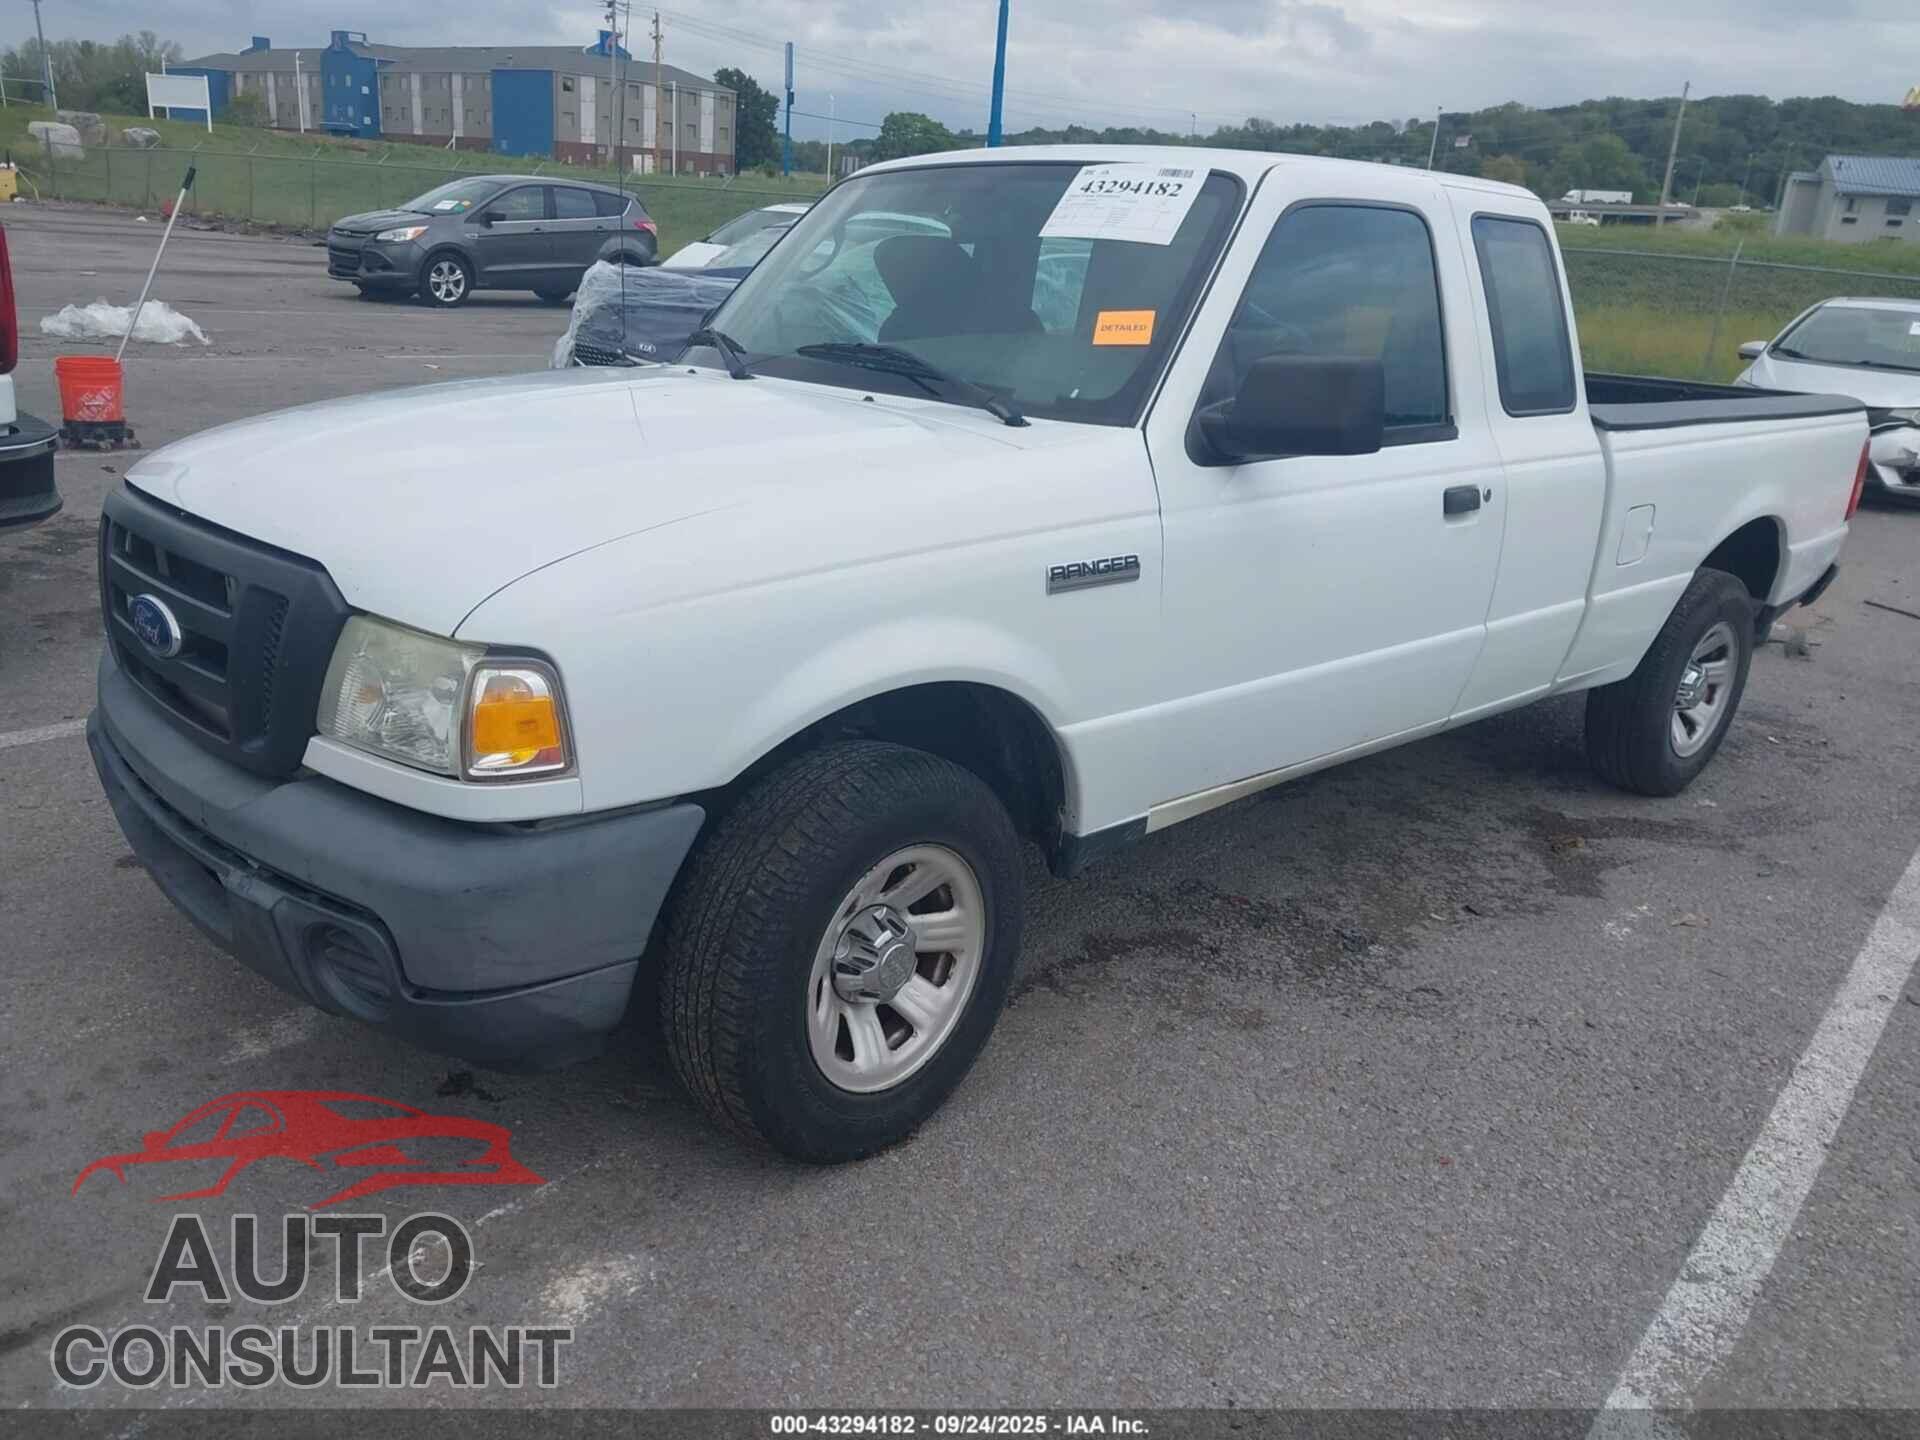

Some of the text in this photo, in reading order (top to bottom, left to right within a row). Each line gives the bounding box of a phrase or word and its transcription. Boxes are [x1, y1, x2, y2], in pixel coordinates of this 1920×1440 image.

[1079, 178, 1184, 198] 43294182
[1100, 323, 1147, 332] DETAILED
[1049, 554, 1140, 582] RANGER
